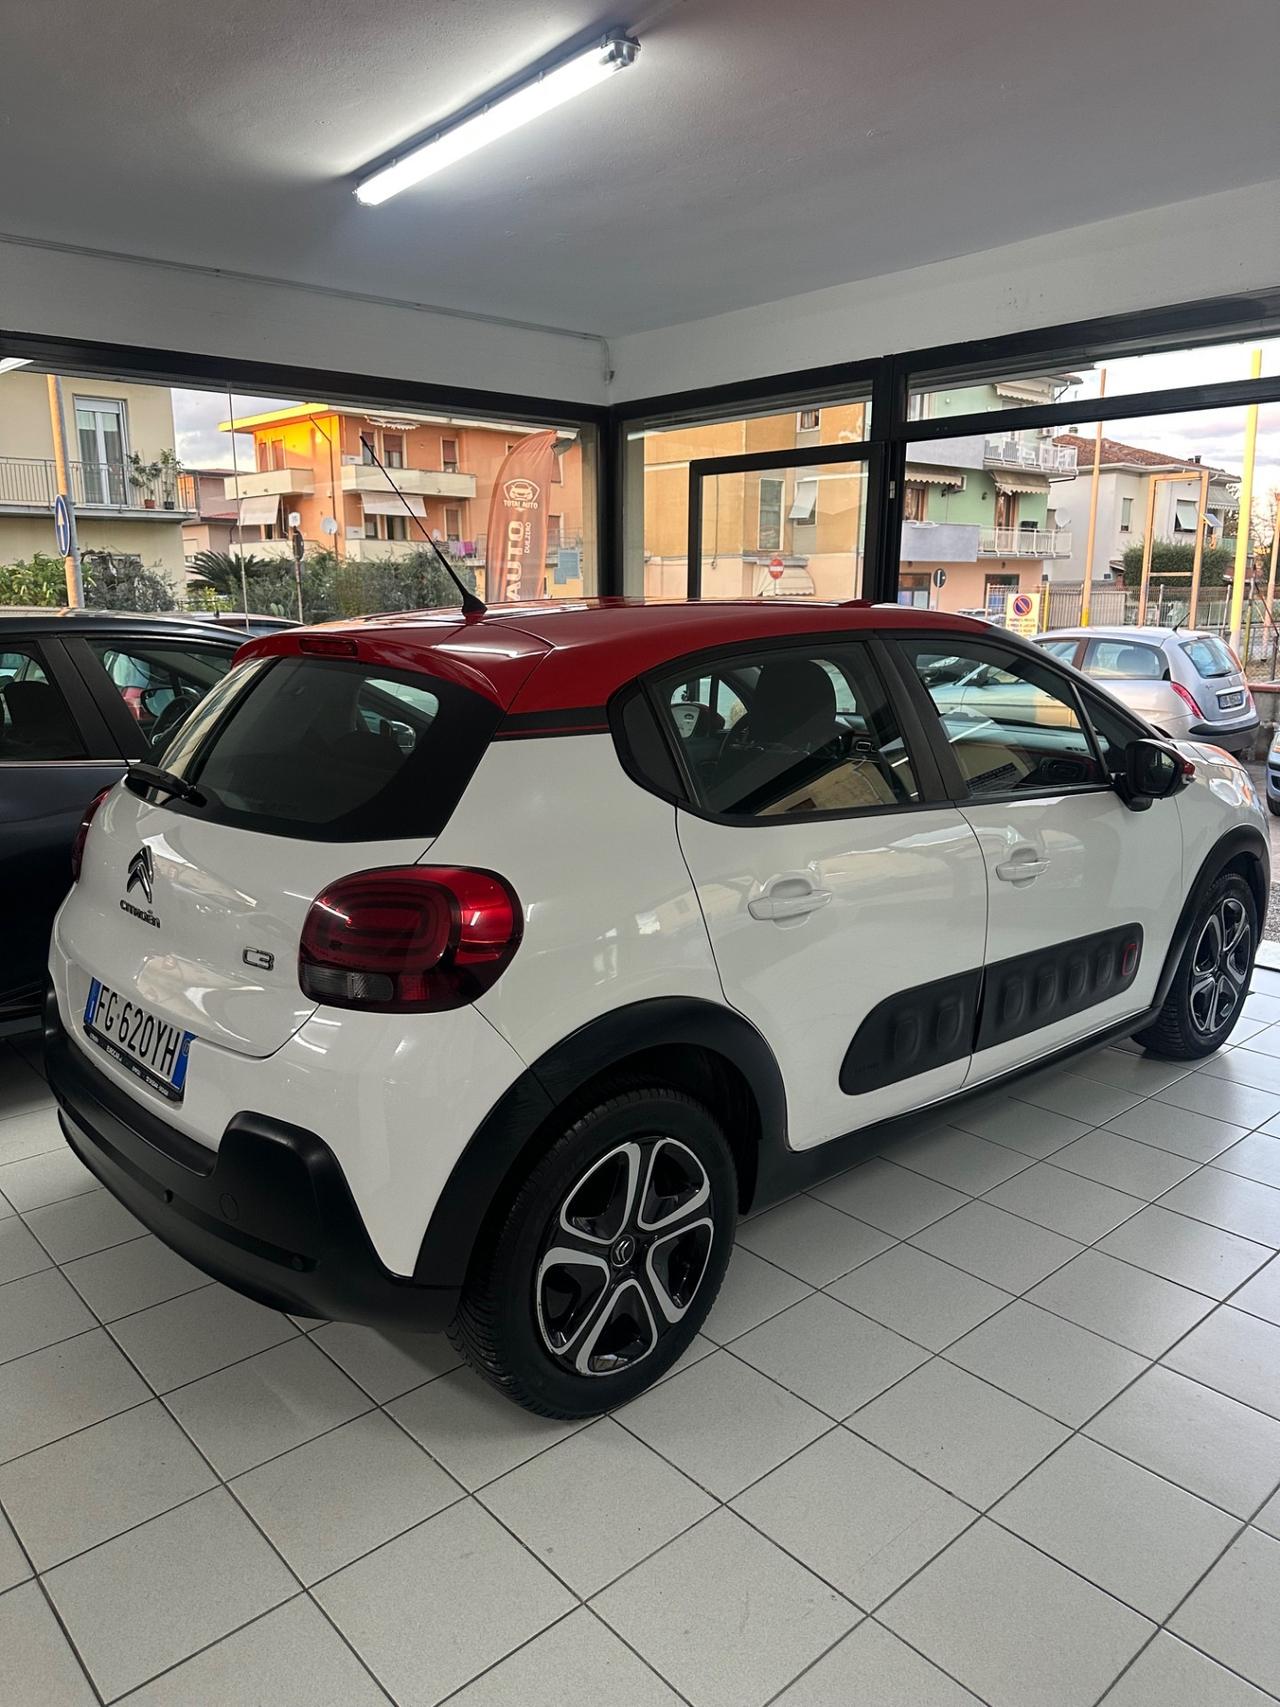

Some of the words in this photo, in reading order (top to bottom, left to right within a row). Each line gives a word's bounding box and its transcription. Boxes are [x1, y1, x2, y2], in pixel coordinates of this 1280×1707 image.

[503, 500, 520, 508] TOTAL
[522, 501, 539, 510] AUTO
[506, 521, 523, 600] AUTO
[242, 946, 275, 972] C3
[95, 984, 118, 1032] FG
[118, 1001, 181, 1076] 620YH
